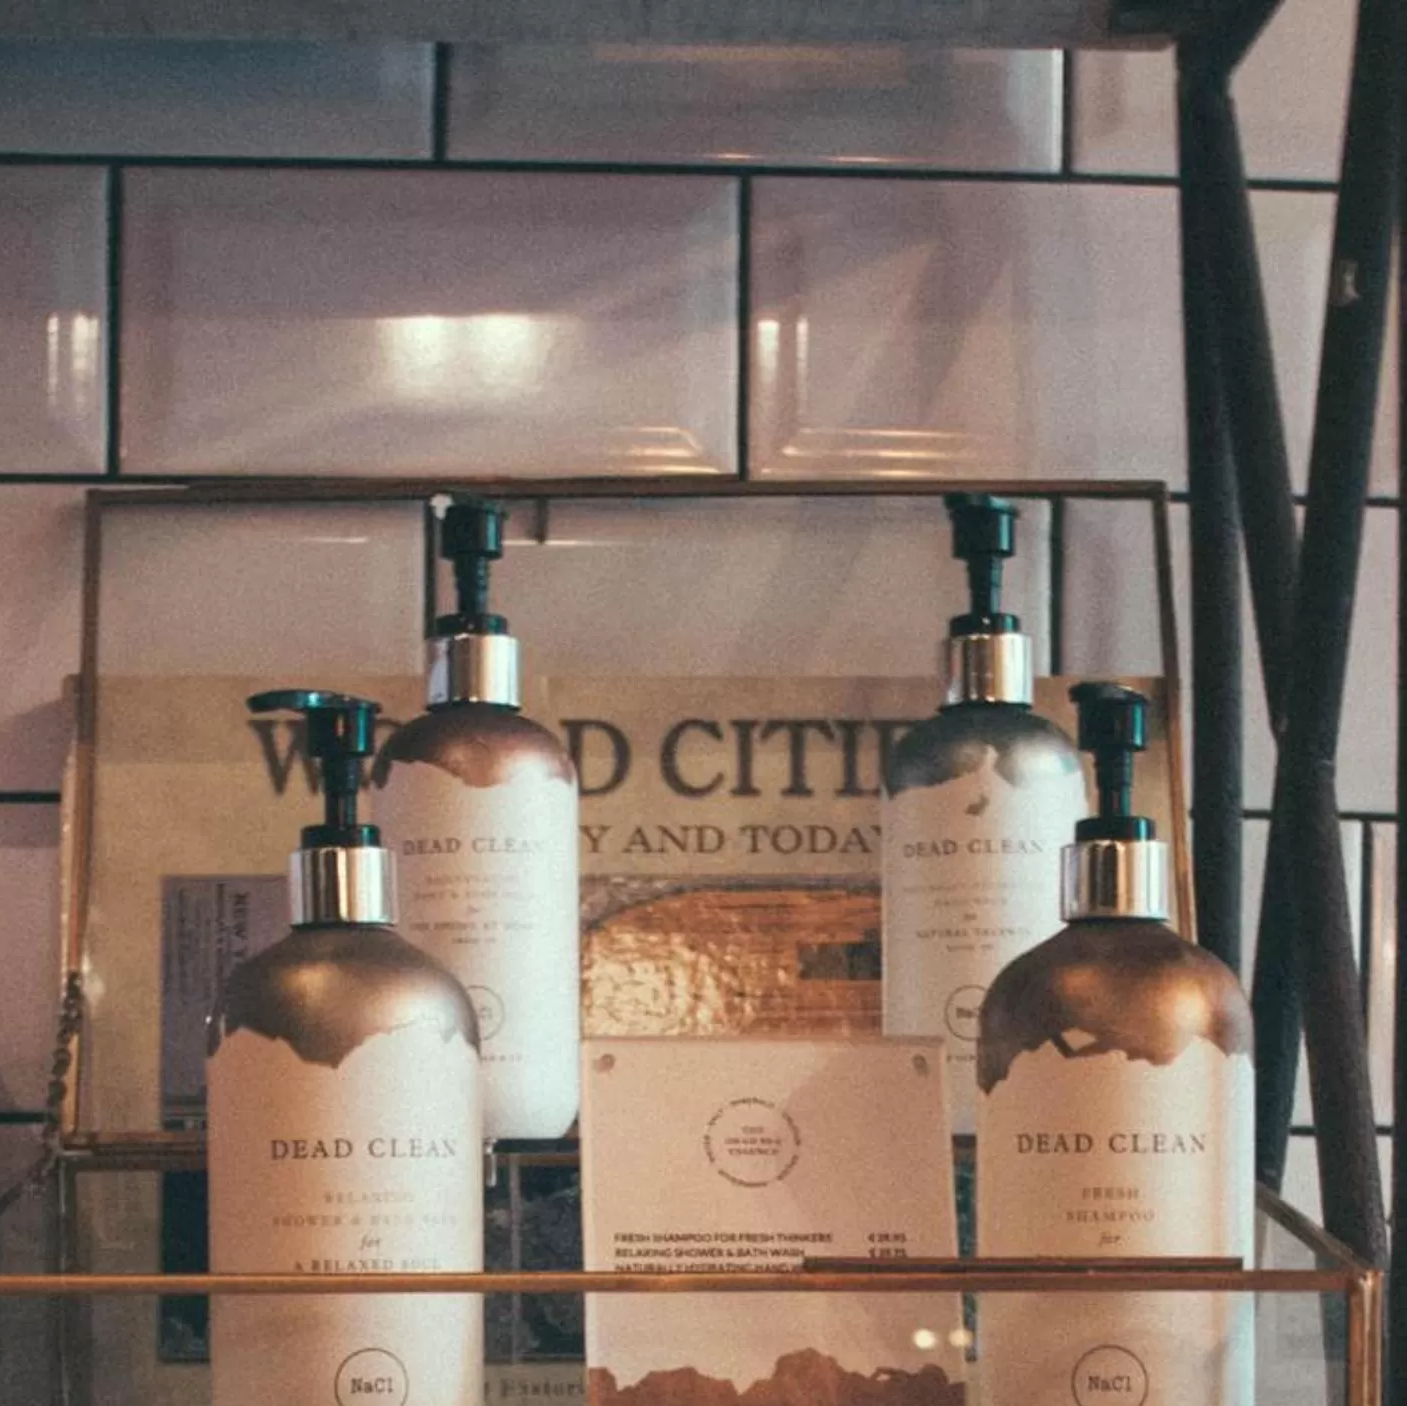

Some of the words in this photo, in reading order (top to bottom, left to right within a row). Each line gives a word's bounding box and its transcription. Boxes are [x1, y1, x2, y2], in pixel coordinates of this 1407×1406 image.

[659, 717, 916, 798] CITIE
[401, 837, 462, 858] DEAD
[471, 836, 545, 854] CLEAN
[628, 824, 725, 855] AND
[738, 823, 882, 855] TODA
[902, 839, 959, 859] DEAD
[966, 837, 1044, 855] CLEAN
[270, 1138, 353, 1161] DEAD
[367, 1136, 458, 1160] CLEAN
[1015, 1133, 1095, 1155] DEAD
[1108, 1132, 1207, 1155] CLEAN
[1080, 1186, 1140, 1201] FRESH
[273, 1213, 343, 1227] SHOWER
[1065, 1209, 1156, 1223] SHAMPOO
[359, 1233, 382, 1250] for
[614, 1232, 650, 1243] FRESH
[652, 1232, 712, 1243] SHAMPOO
[713, 1232, 737, 1243] FOR
[738, 1232, 775, 1243] FRESH
[776, 1232, 833, 1243] THINKERS
[1098, 1231, 1121, 1247] for
[614, 1247, 671, 1258] RELAXING
[672, 1247, 725, 1258] SHOWER
[725, 1247, 736, 1258] &
[736, 1247, 769, 1258] BATH
[769, 1247, 806, 1258] WASH
[311, 1258, 395, 1272] RELAXED
[349, 1376, 394, 1395] NaCl
[1087, 1375, 1134, 1393] NaCl
